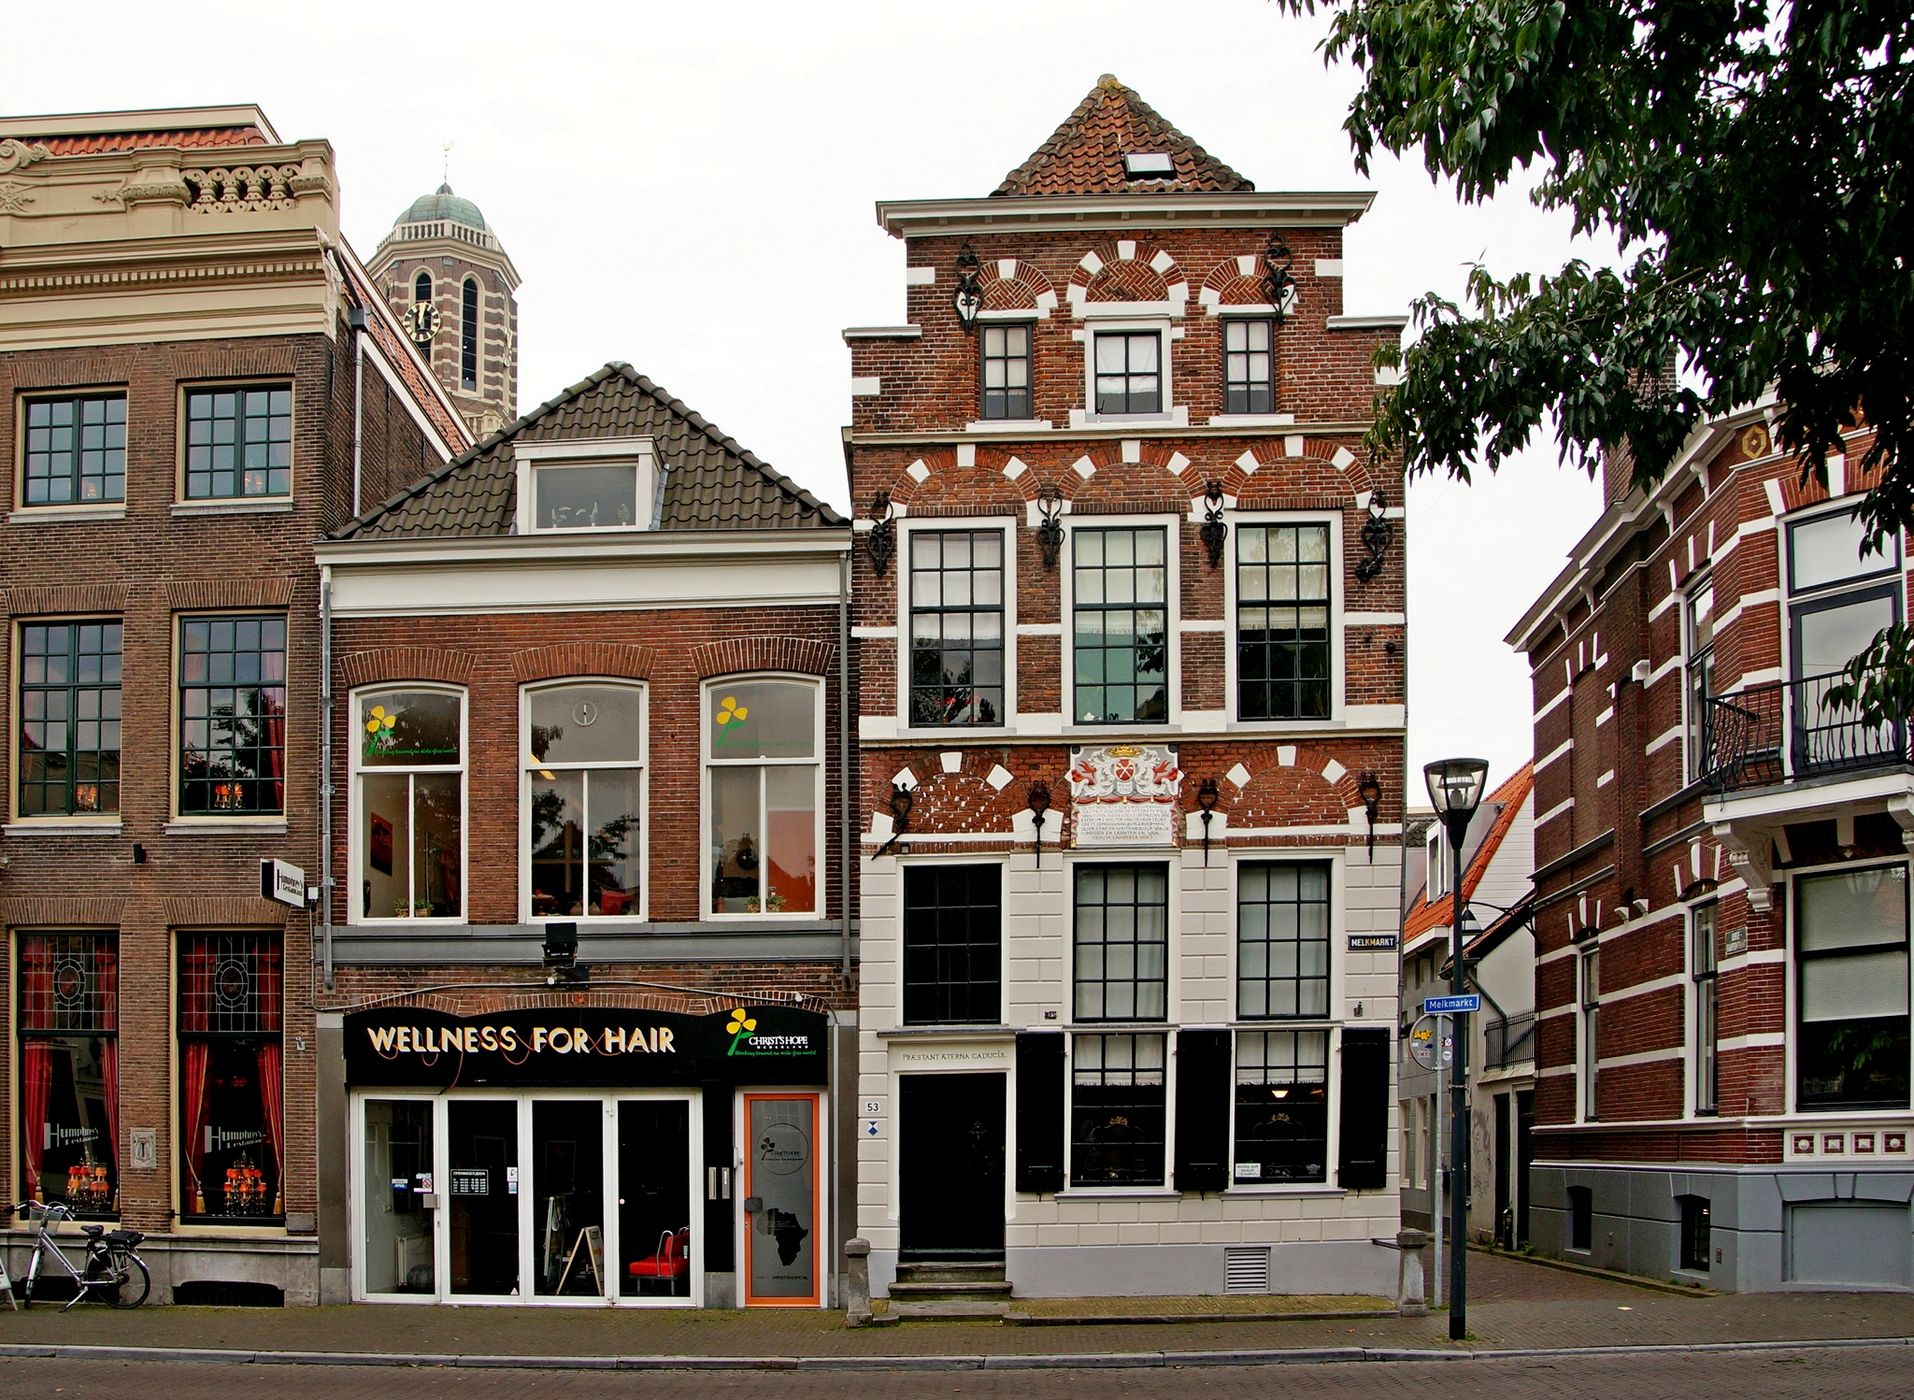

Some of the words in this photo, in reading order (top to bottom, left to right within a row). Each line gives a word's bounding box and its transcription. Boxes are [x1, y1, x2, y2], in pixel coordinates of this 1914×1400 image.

[1351, 937, 1394, 947] MELKMARKT
[1429, 999, 1473, 1009] Melkmarkt
[367, 1026, 516, 1053] WELLNESS
[533, 1026, 590, 1054] FOR
[605, 1026, 676, 1053] HAIR
[748, 1035, 785, 1046] CHRIST'S
[785, 1035, 808, 1045] HOPE
[866, 1103, 879, 1112] 53
